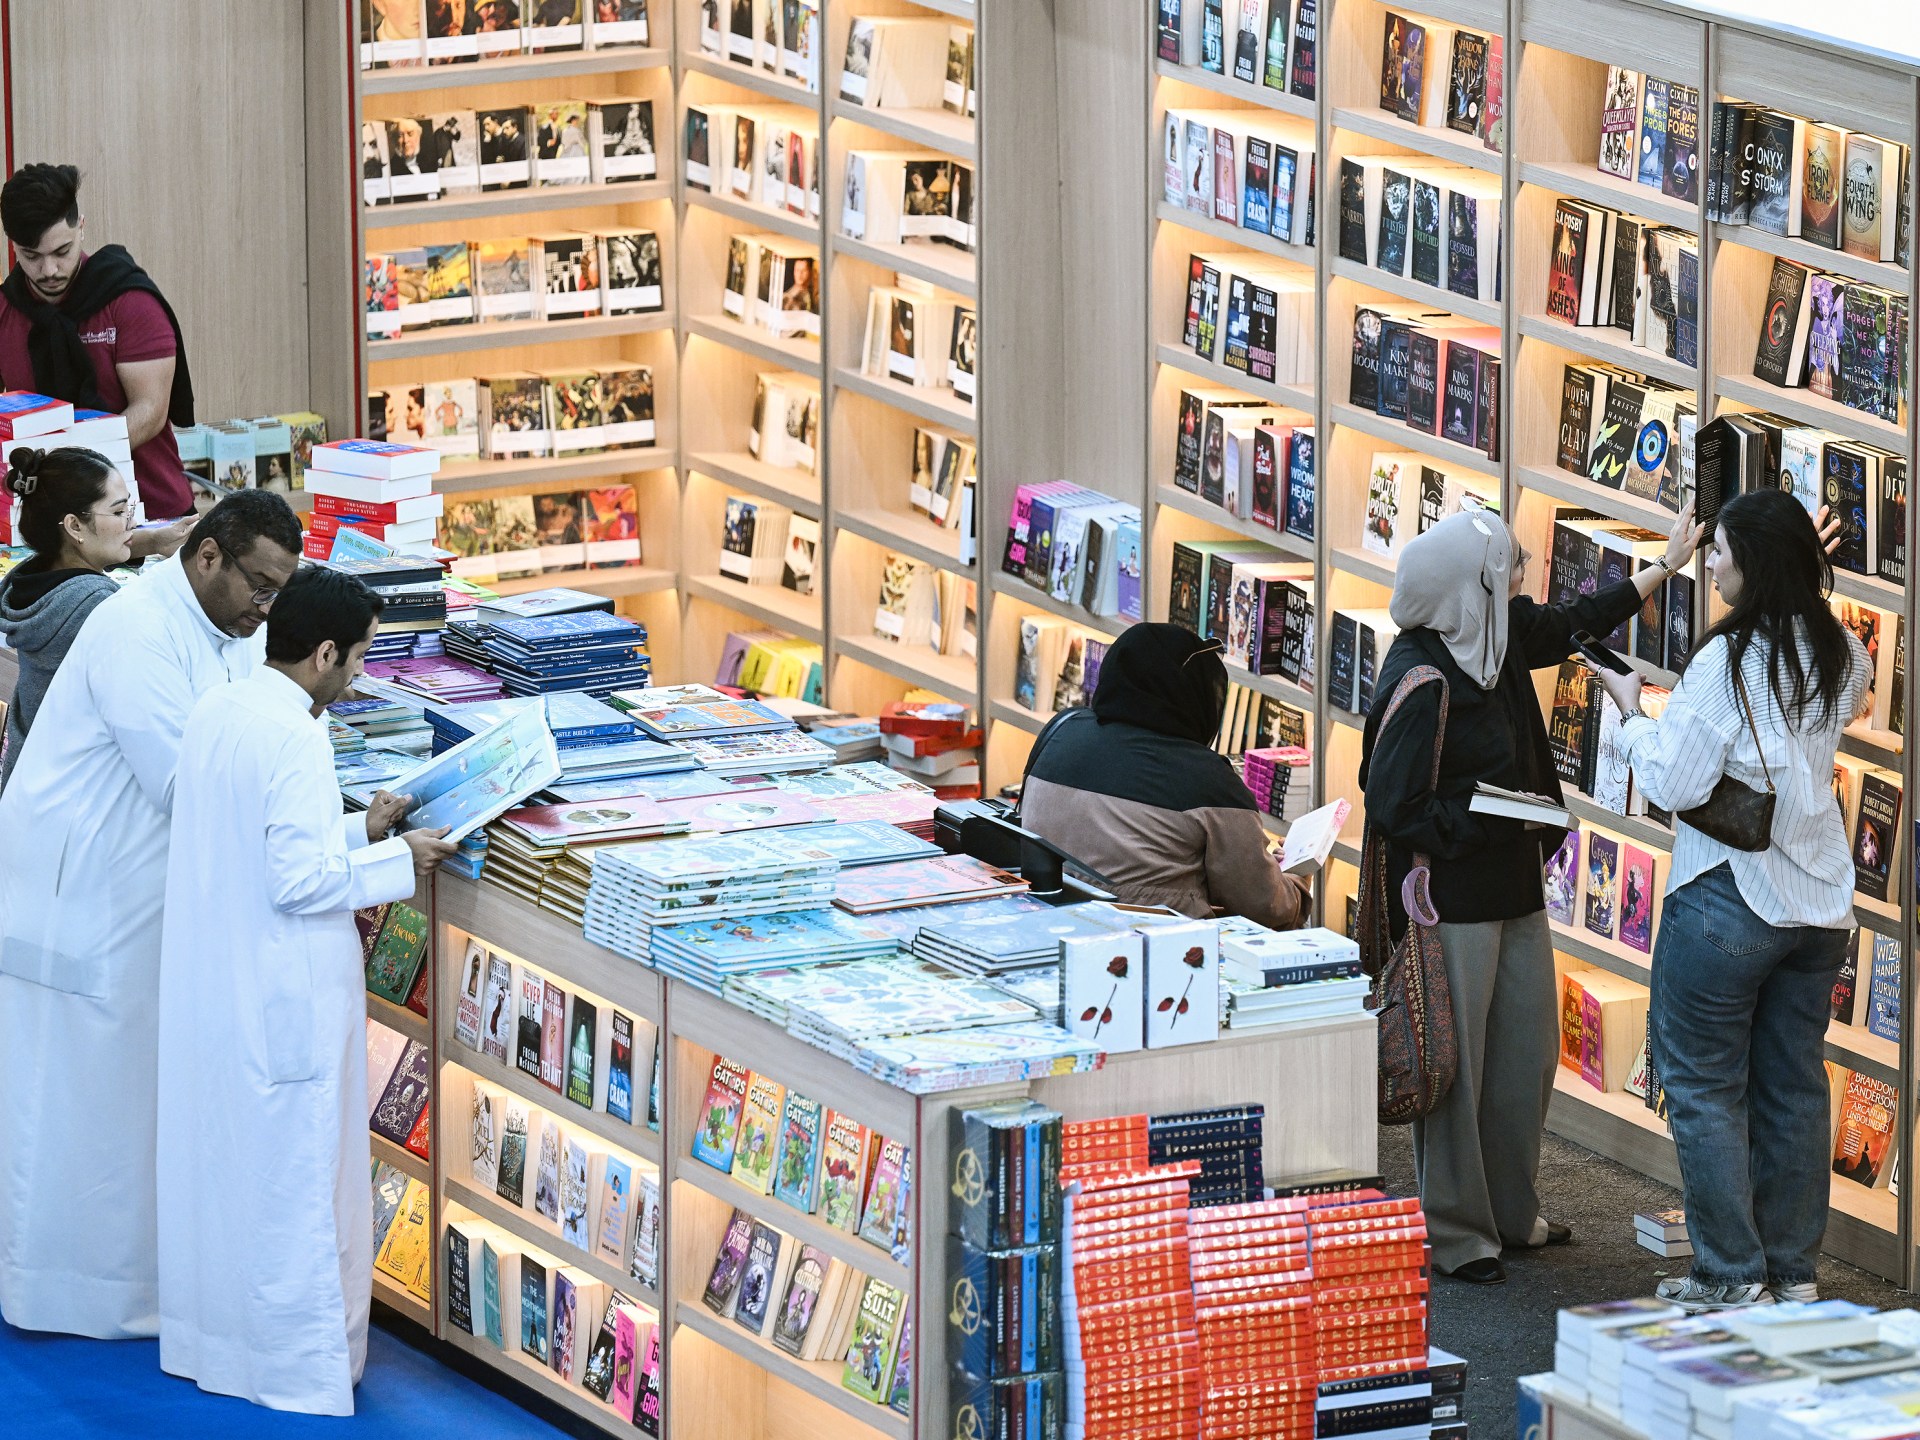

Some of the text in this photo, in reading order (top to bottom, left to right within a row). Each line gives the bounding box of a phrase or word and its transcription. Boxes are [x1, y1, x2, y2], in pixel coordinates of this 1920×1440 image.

[1647, 80, 1667, 95] CIXIN
[1670, 88, 1688, 103] CIXIN
[1668, 106, 1681, 118] THE
[1757, 146, 1784, 171] ONYX
[1808, 164, 1829, 184] IRON
[1754, 172, 1784, 199] STORM
[1845, 177, 1875, 202] FOURTH
[1808, 187, 1830, 205] FLAME
[1846, 198, 1875, 223] WING
[1564, 213, 1582, 233] COSBY
[1449, 239, 1475, 258] CROSSED
[1558, 276, 1566, 290] OF
[1548, 290, 1576, 320] ASHES
[1846, 312, 1876, 328] FORGET
[1856, 331, 1868, 341] ME
[1756, 358, 1763, 366] ED
[1861, 348, 1877, 359] NOT
[1414, 360, 1430, 378] KING
[1854, 366, 1872, 378] STACY
[1410, 373, 1435, 395] MAKERS
[1452, 370, 1469, 388] KING
[1845, 374, 1884, 391] WILLINGHAM
[1447, 385, 1472, 404] MAKERS
[1564, 382, 1590, 409] WOVEN
[1607, 411, 1638, 430] HANNAH
[1561, 422, 1587, 454] CLAY
[1612, 442, 1625, 454] Away
[1782, 440, 1804, 457] Rebecca
[1372, 474, 1398, 499] BRUTAL
[359, 508, 378, 516] NATURE
[313, 524, 329, 532] GREENE
[308, 542, 324, 550] ROBERT
[1586, 549, 1599, 563] TRUE
[1556, 564, 1578, 580] NEVER
[1584, 560, 1598, 575] LOVE
[1555, 574, 1576, 592] AFTER
[1568, 704, 1577, 719] OF
[572, 728, 594, 737] BUILD-IT
[1591, 834, 1614, 868] Cress
[522, 979, 541, 1006] NEVER
[547, 987, 562, 1006] FREIDA
[526, 1002, 536, 1023] LIE
[544, 999, 564, 1020] McFADDEN
[1565, 1010, 1582, 1027] SILVER
[615, 1016, 628, 1033] FREIDA
[613, 1029, 630, 1050] McFADDEN
[522, 1045, 538, 1063] FREIDA
[518, 1056, 540, 1079] McFADDEN
[540, 1060, 562, 1090] TENANT
[719, 1056, 746, 1077] Investi
[572, 1074, 588, 1094] FREIDA
[754, 1073, 779, 1099] Investi
[1855, 1072, 1896, 1096] BRANDON
[569, 1086, 592, 1109] McFADDEN
[610, 1083, 628, 1110] CRASH
[789, 1090, 817, 1116] Investi
[1848, 1083, 1896, 1111] SANDERSON
[1852, 1102, 1888, 1124] ARCANUM
[833, 1110, 860, 1136] Investi
[1846, 1112, 1888, 1134] UNBOUNDED
[1165, 1125, 1239, 1140] SEDUCTION
[1174, 1138, 1246, 1154] SEDUCTION
[884, 1144, 904, 1168] GAT
[1094, 1184, 1160, 1204] POWER
[1292, 1182, 1362, 1199] MASTERY
[1094, 1198, 1160, 1218] POWER
[1094, 1213, 1160, 1232] POWER
[1210, 1216, 1275, 1234] POWER
[1333, 1216, 1397, 1233] POWER
[1094, 1228, 1160, 1246] POWER
[1334, 1230, 1399, 1246] POWER
[454, 1255, 463, 1270] THE
[452, 1266, 464, 1282] LAST
[1218, 1272, 1284, 1289] POWER
[451, 1275, 466, 1293] THING
[529, 1284, 538, 1300] THE
[1099, 1283, 1162, 1302] POWER
[455, 1290, 462, 1302] HE
[1335, 1286, 1400, 1301] POWER
[449, 1296, 470, 1318] TOLD ME
[862, 1289, 896, 1325] S.U.I.T.
[1099, 1296, 1164, 1315] POWER
[1334, 1310, 1397, 1328] POWER
[1334, 1362, 1400, 1379] POWER
[1107, 1374, 1172, 1394] POWER
[1334, 1376, 1406, 1392] SEDUCTION
[1107, 1401, 1172, 1418] POWER
